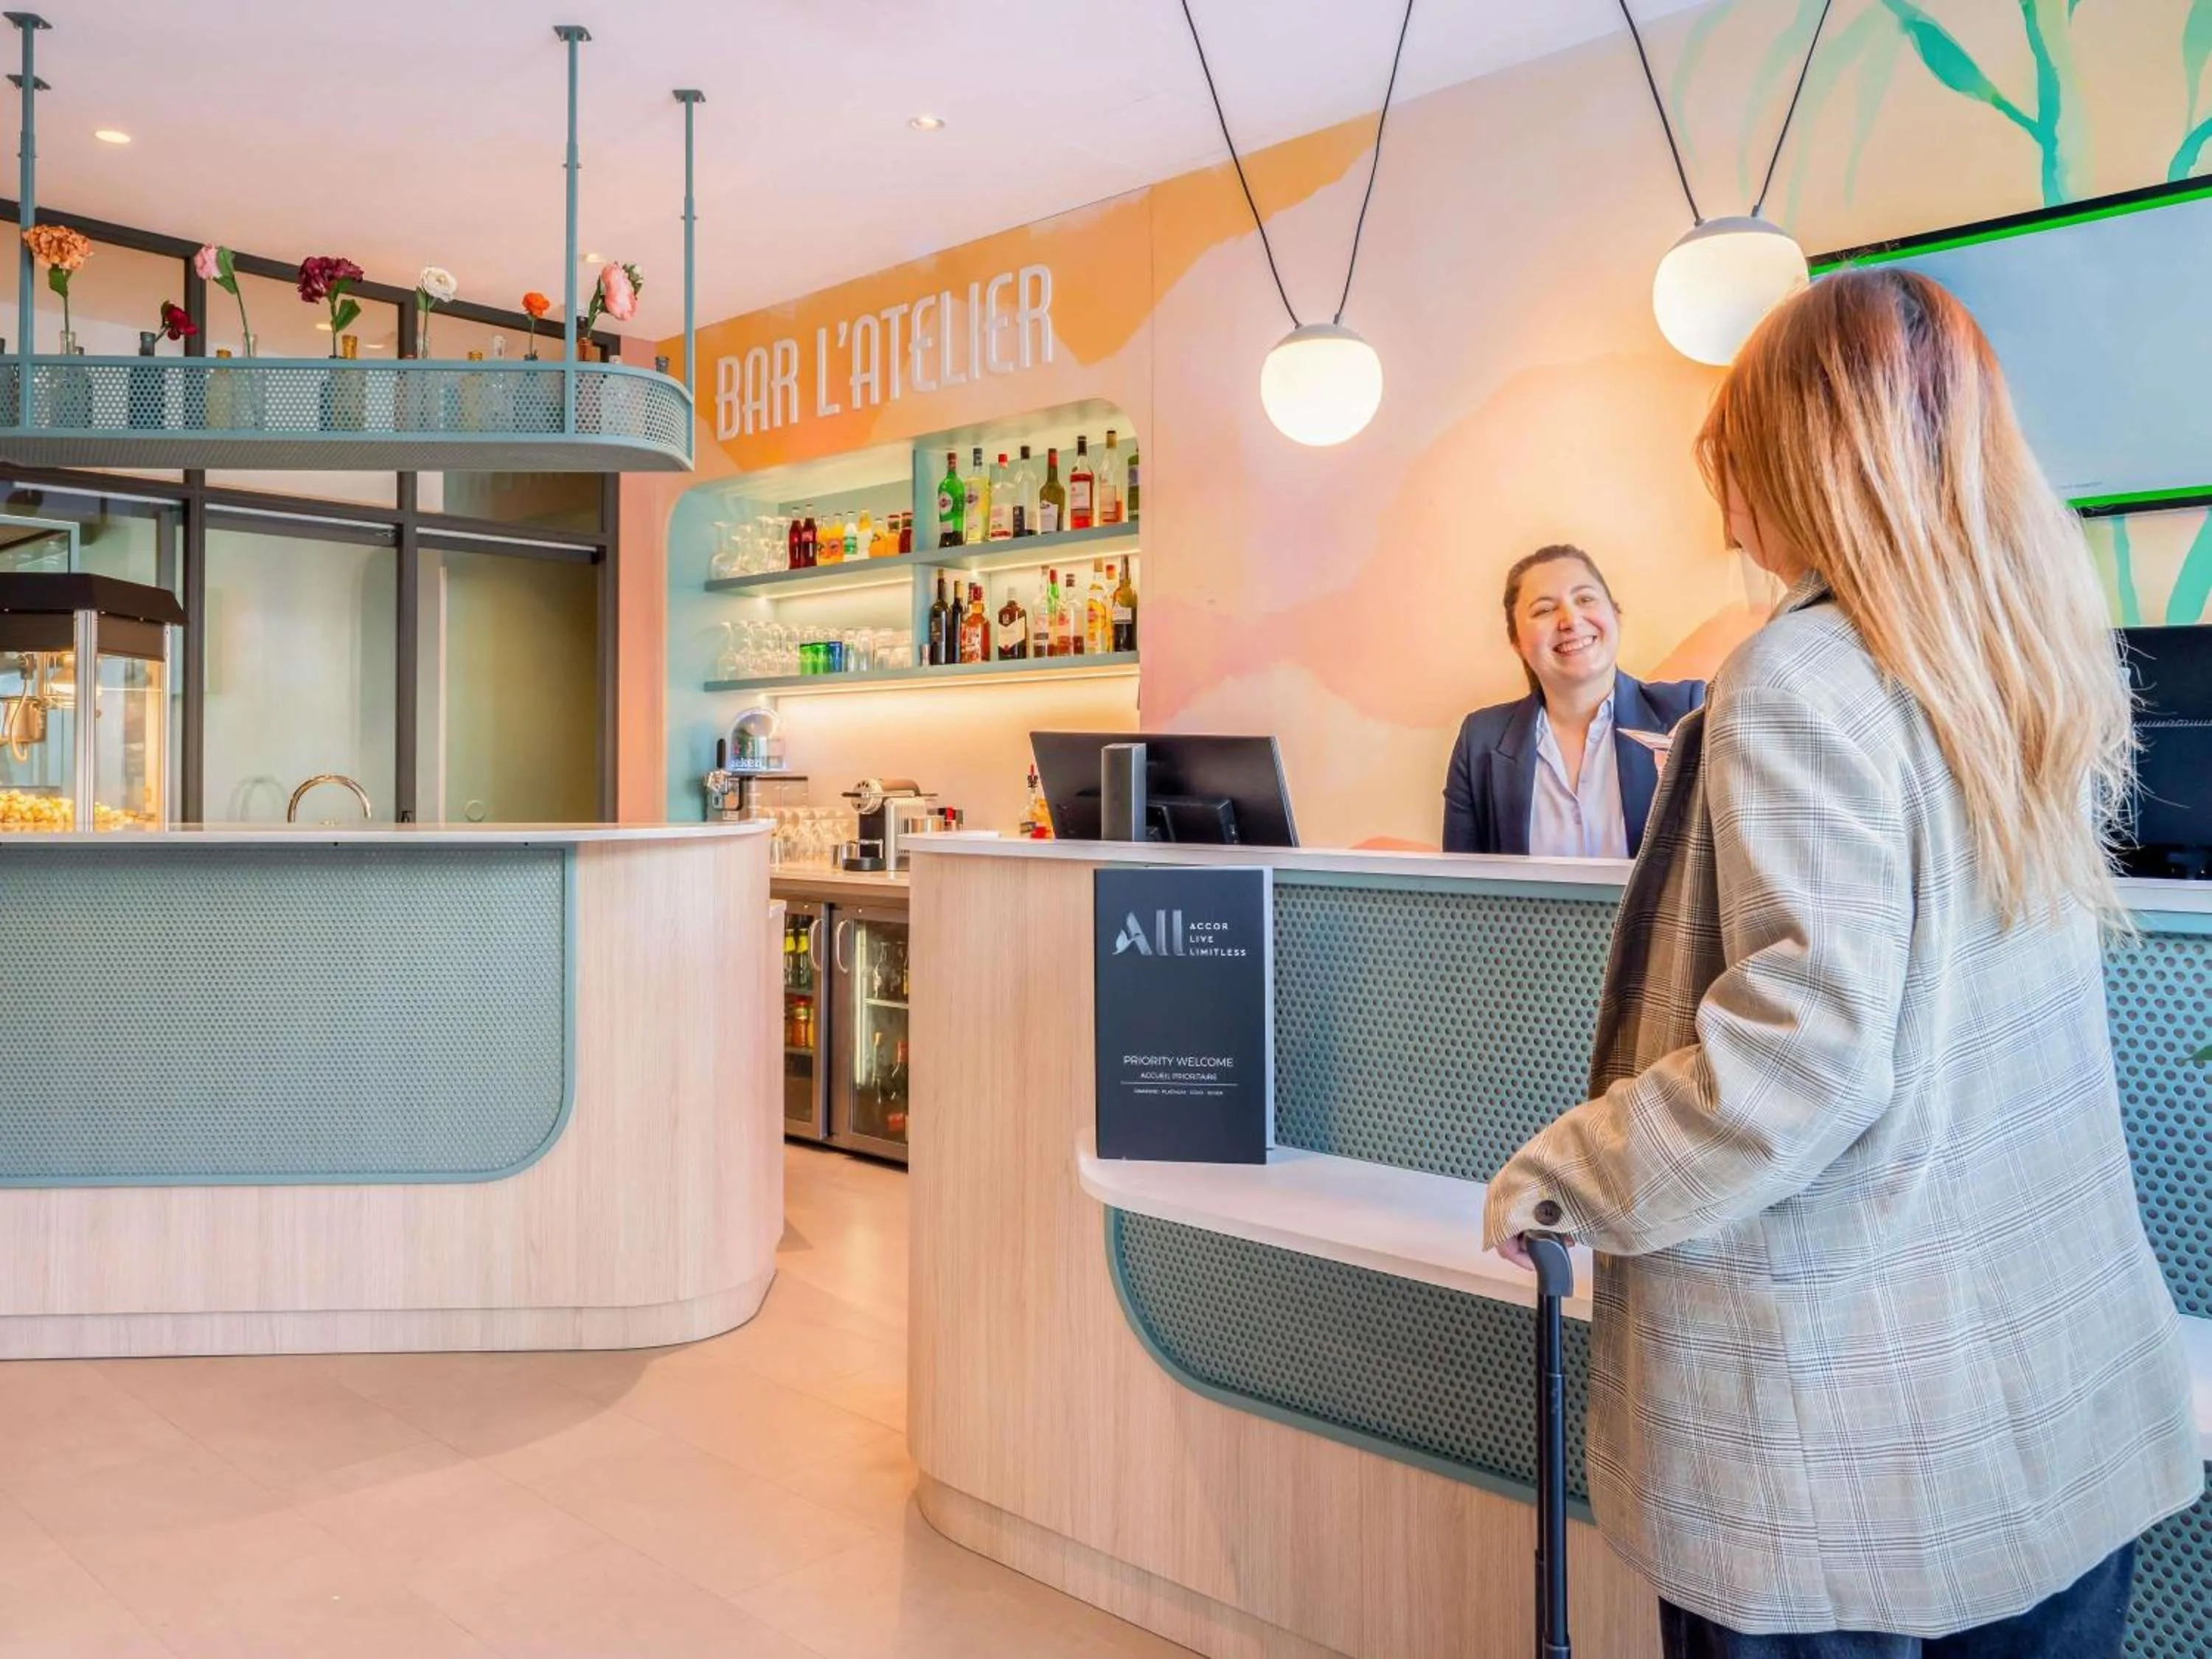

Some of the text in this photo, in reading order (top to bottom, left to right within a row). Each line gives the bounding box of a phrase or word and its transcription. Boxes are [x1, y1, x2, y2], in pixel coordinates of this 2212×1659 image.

[715, 264, 1053, 441] BAR L'ATELIER
[1189, 948, 1247, 956] LIMITLESS
[1123, 1055, 1234, 1067] PRIORITY WELCOME
[1141, 1072, 1170, 1080] ACCUEIL
